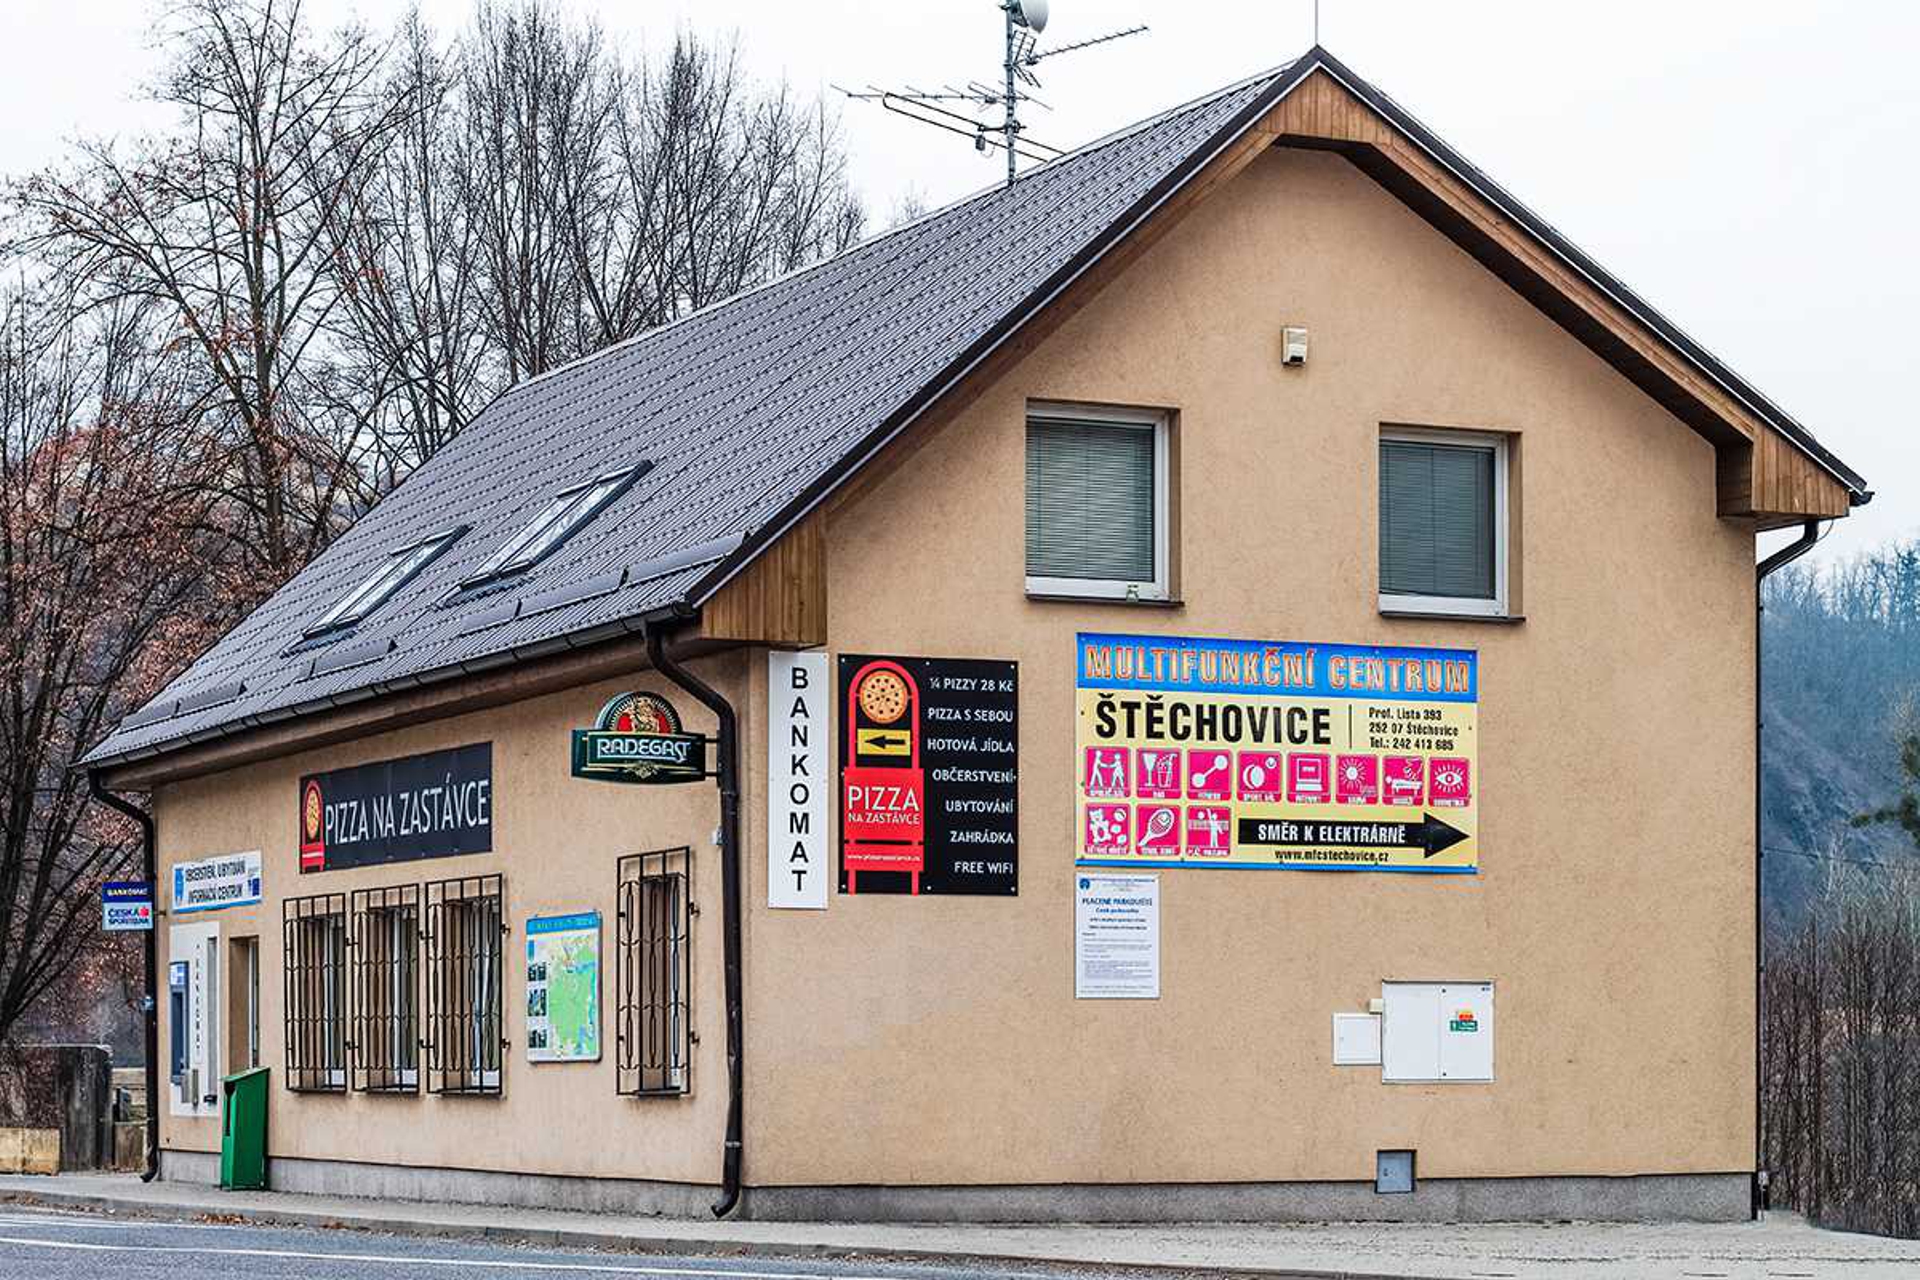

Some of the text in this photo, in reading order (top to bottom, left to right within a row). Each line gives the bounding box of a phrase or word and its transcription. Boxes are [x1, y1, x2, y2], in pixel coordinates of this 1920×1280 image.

[1087, 645, 1469, 693] MULTIFUNKČNÍ CENTRUM
[943, 678, 977, 690] PIZZY
[981, 679, 995, 691] 28
[999, 679, 1014, 692] Kč
[928, 707, 1013, 722] PIZZA S SEBOU
[1096, 693, 1331, 745] ŠTĚCHOVICE
[1368, 707, 1394, 719] Prof.
[1423, 709, 1442, 720] 393
[1369, 721, 1458, 737] 252 07 Štěchovice
[597, 738, 691, 762] RADEGAST
[927, 736, 1014, 753] HOTOVÁ JÍDLA
[1370, 737, 1390, 748] Tel.:
[1392, 737, 1412, 749] 242
[1414, 738, 1432, 750] 413
[790, 667, 809, 891] BANKOMAT
[932, 767, 1013, 783] OBČERSTVENÍ
[848, 785, 920, 811] PIZZA
[945, 798, 1013, 813] UBYTOVÁNÍ
[326, 773, 489, 845] PIZZA NA ZASTÁVCE
[848, 811, 920, 825] NA ZASTÁVCE
[949, 829, 1014, 844] ZAHRÁDKA
[1258, 822, 1406, 844] SMĚR K ELEKTRÁRNĚ
[1275, 850, 1389, 862] www.mfcstechovice.cz
[954, 861, 1013, 874] FREE WIFI
